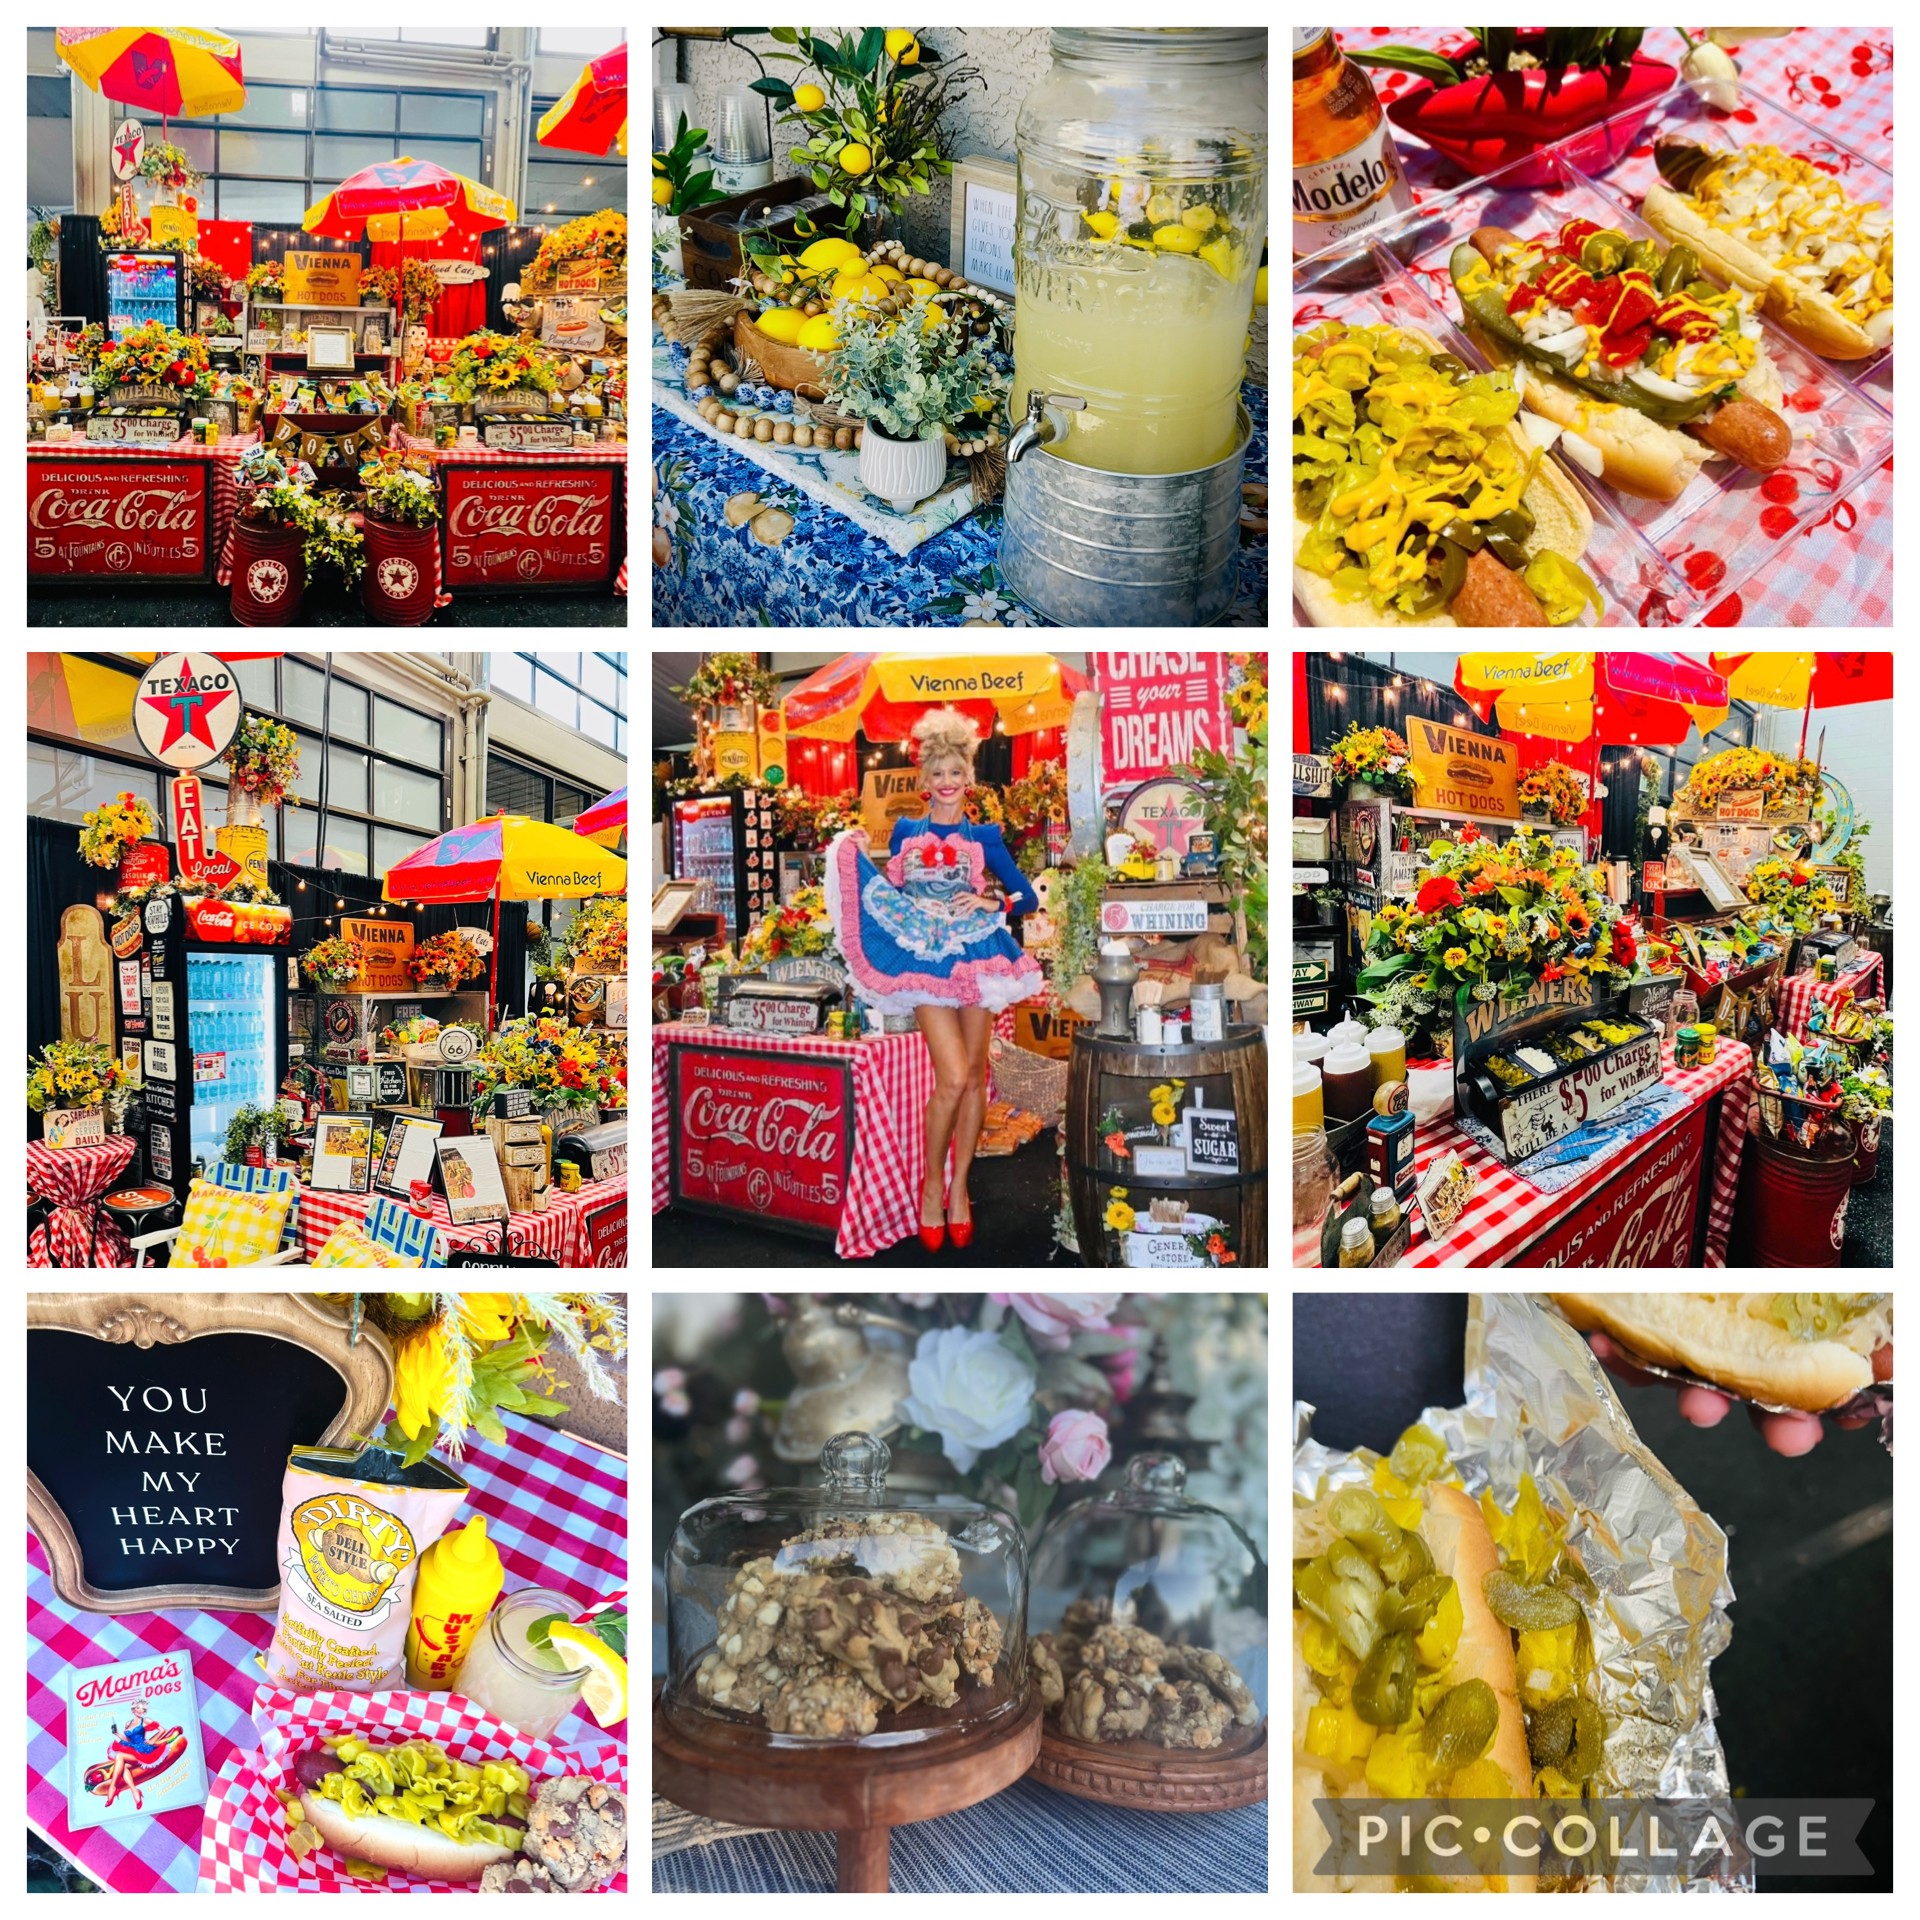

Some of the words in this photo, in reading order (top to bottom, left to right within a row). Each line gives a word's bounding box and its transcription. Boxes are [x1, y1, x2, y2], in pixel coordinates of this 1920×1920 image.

[116, 127, 142, 145] TEXACO
[1308, 163, 1351, 180] CERVEZA
[1293, 158, 1386, 212] Modelo
[122, 187, 131, 229] EAT
[973, 198, 993, 215] WHEN
[997, 206, 1012, 220] LIFE
[972, 218, 994, 236] GIVES
[1000, 227, 1014, 242] YOU
[1324, 212, 1378, 238] Especial
[971, 239, 1001, 258] LEMONS
[294, 254, 351, 270] VIENNA
[430, 264, 451, 274] Good
[455, 264, 475, 275] Eats
[971, 259, 992, 281] MAKE
[559, 280, 574, 289] HOT
[575, 278, 597, 289] DOGS
[297, 291, 317, 301] HOT
[320, 291, 346, 302] DOGS
[115, 384, 181, 403] WIENERS
[140, 419, 172, 430] Charge
[534, 425, 565, 436] Charge
[542, 436, 570, 444] Whining
[42, 473, 102, 483] DELICIOUS
[121, 474, 189, 483] REFRESHING
[463, 480, 518, 489] DELICIOUS
[536, 480, 597, 489] REFRESHING
[29, 488, 202, 530] Coca-Cola
[450, 494, 609, 537] Coca-Cola
[381, 558, 417, 575] GASOLINE
[1108, 652, 1207, 681] CHASE
[1484, 663, 1531, 680] Vienna
[1534, 659, 1570, 676] Beef
[148, 674, 229, 695] TEXACO
[911, 675, 977, 693] Vienna
[982, 671, 1023, 692] Beef
[1137, 683, 1183, 710] your
[170, 695, 203, 734] T
[1111, 708, 1212, 770] DREAMS
[1422, 724, 1506, 765] VIENNA
[874, 775, 921, 798] VIEN
[1436, 788, 1467, 806] HOT
[1470, 793, 1505, 812] DOGS
[178, 782, 201, 860] EAT
[1720, 808, 1736, 817] HOT
[1738, 808, 1760, 817] DOGS
[190, 859, 232, 880] Local
[527, 871, 571, 886] Vienna
[573, 871, 602, 888] Beef
[149, 905, 163, 915] STAY
[1140, 903, 1175, 912] CHARGE
[1176, 903, 1195, 912] FOR
[197, 911, 235, 928] Coca-Cola
[239, 921, 254, 931] ICE
[258, 921, 285, 932] COLD
[1131, 914, 1207, 930] WHINING
[124, 920, 140, 941] DOGS
[350, 923, 405, 943] VIENNA
[378, 975, 403, 987] DOGS
[776, 961, 843, 988] WIENERS
[397, 1006, 420, 1019] FREE
[777, 1003, 811, 1016] Charge
[772, 1017, 783, 1026] for
[783, 1017, 815, 1031] Whining
[153, 1047, 166, 1058] FREE
[448, 1045, 464, 1055] 66
[152, 1060, 168, 1073] HUGS
[1516, 1083, 1554, 1107] THERE
[1603, 1042, 1652, 1077] Charge
[694, 1066, 745, 1083] DELICIOUS
[761, 1074, 827, 1093] REFRESHING
[146, 1093, 175, 1109] KITCHEN
[1600, 1086, 1617, 1103] for
[70, 1107, 101, 1124] SARCASM
[683, 1086, 841, 1163] Coca-Cola
[1199, 1118, 1231, 1132] Sweet
[75, 1125, 100, 1136] SERVED
[75, 1135, 101, 1146] DAILY
[1194, 1139, 1238, 1158] SUGAR
[1513, 1138, 1543, 1158] WILL
[1545, 1129, 1560, 1143] BE
[191, 1188, 235, 1200] MARKET
[1585, 1210, 1612, 1240] AND
[1613, 1132, 1692, 1216] REFRESHING
[1148, 1239, 1193, 1255] GENERA
[1161, 1254, 1189, 1262] STORE
[107, 1386, 207, 1413] YOU
[105, 1430, 227, 1456] MAKE
[142, 1471, 201, 1493] MY
[111, 1506, 239, 1526] HEART
[120, 1537, 240, 1555] HAPPY
[329, 1545, 368, 1570] STYLE
[308, 1554, 341, 1597] POTATO
[343, 1586, 380, 1606] CHIPS
[305, 1592, 321, 1612] SEA
[323, 1605, 363, 1628] SALTED
[282, 1611, 325, 1648] Artfully
[282, 1624, 326, 1663] Partially
[430, 1612, 473, 1680] MUSTARD
[316, 1662, 355, 1680] Kettle
[356, 1665, 389, 1684] Style
[76, 1658, 183, 1708] Mama's
[144, 1681, 182, 1698] DOGS
